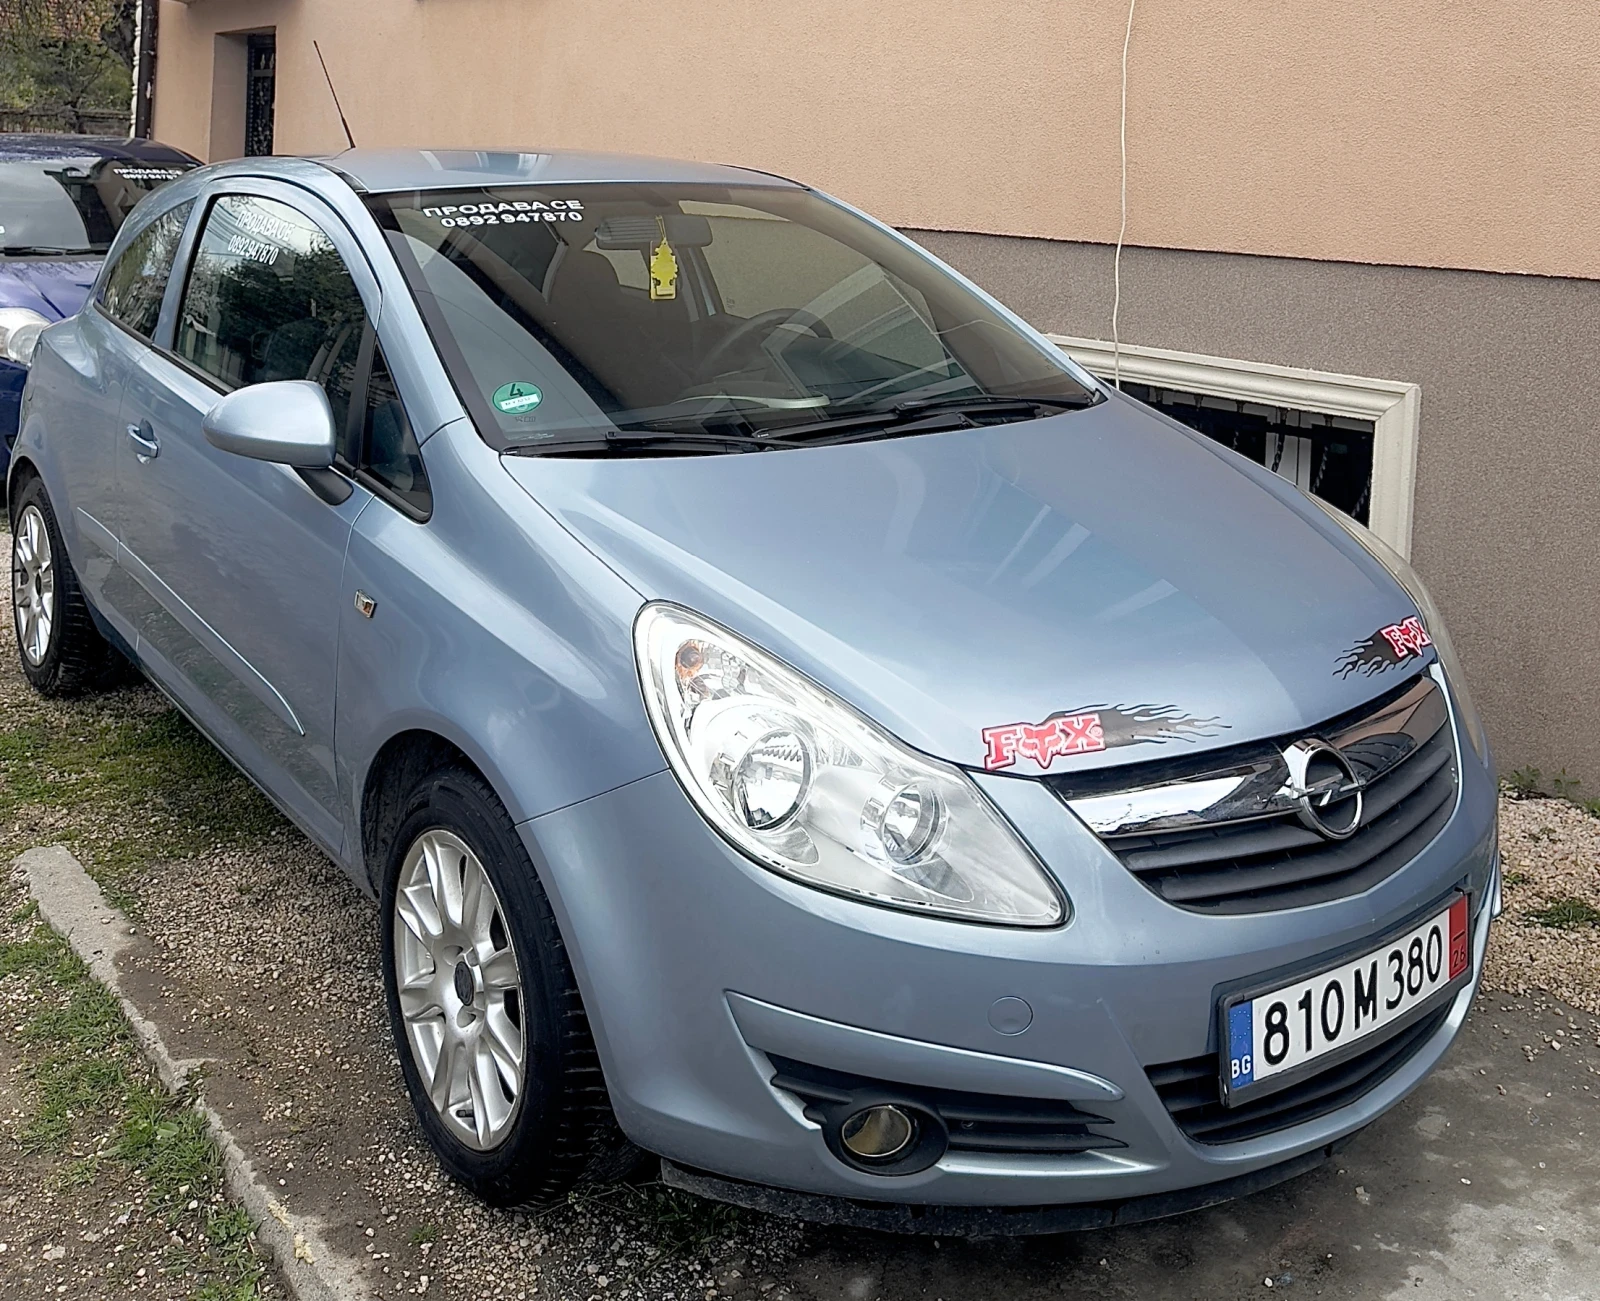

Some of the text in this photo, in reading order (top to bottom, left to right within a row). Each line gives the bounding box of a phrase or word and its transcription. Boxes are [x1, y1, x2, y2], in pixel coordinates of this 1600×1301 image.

[422, 200, 584, 217] ПРОДАВА СЕ
[235, 211, 280, 239] ПРОДАВА
[441, 211, 583, 228] 0892 947870
[227, 234, 280, 266] 0892 947870
[510, 383, 523, 396] 4
[1230, 1054, 1252, 1079] BG
